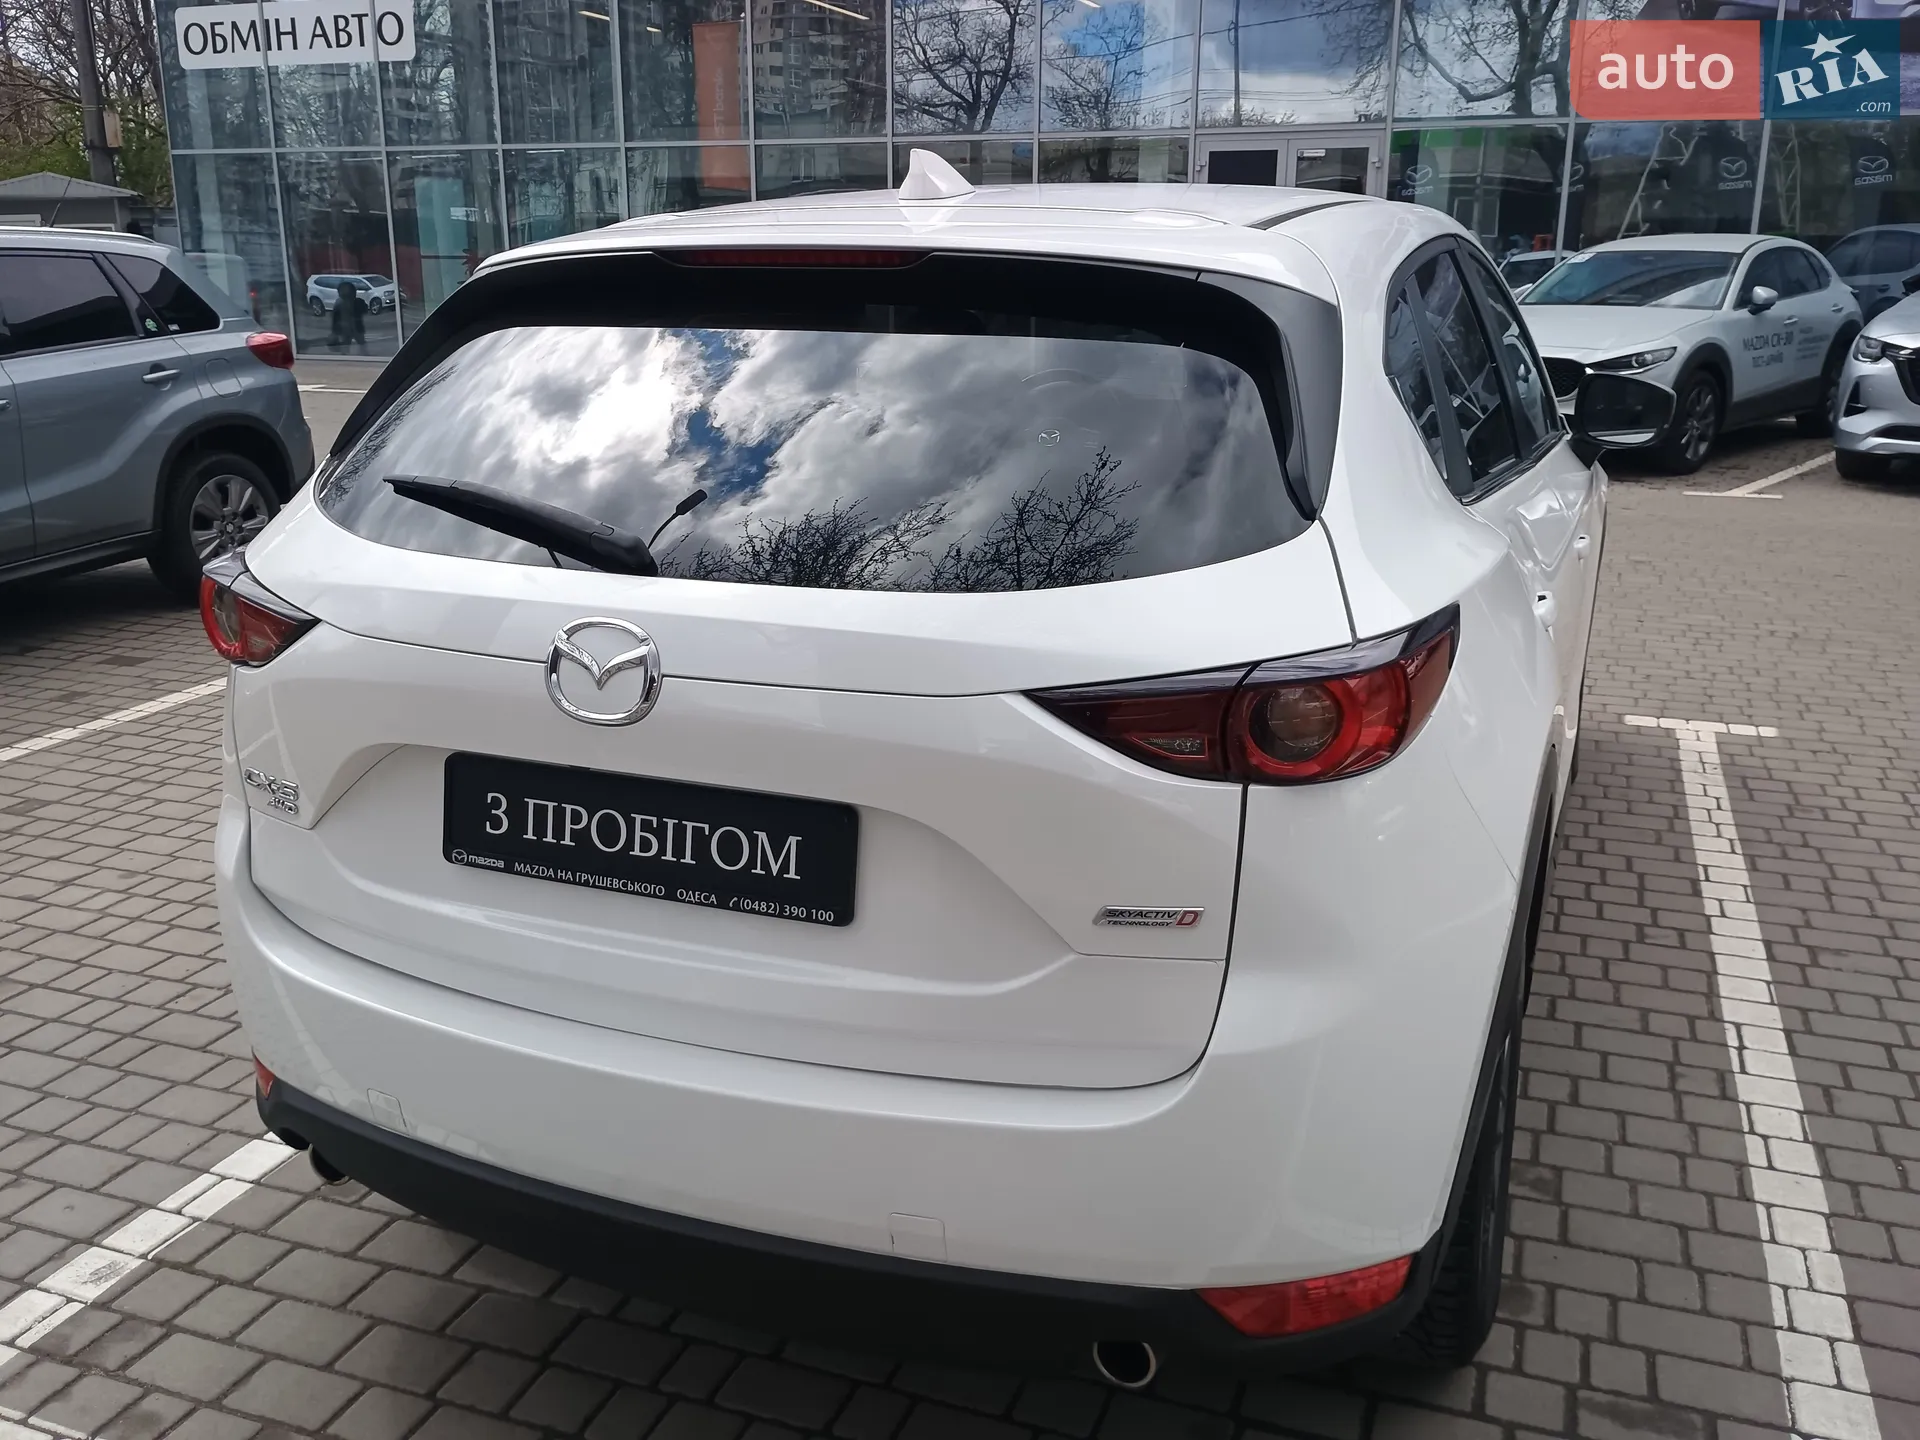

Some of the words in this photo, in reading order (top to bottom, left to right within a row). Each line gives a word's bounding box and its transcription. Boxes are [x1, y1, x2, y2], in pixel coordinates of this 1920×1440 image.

[183, 17, 299, 56] ОБМІН
[309, 10, 405, 50] АВТО
[522, 797, 803, 880] ПРОБІГОМ
[468, 855, 505, 869] mazda
[513, 861, 555, 879] MAZDA
[557, 869, 574, 882] НА
[575, 872, 666, 896] ГРУШЕВСЬКОГО
[676, 888, 718, 906] ОДЕСА
[739, 897, 780, 916] (0482)
[783, 904, 807, 919] 390
[811, 909, 835, 923] 100
[1106, 910, 1178, 919] SKYACTIV
[1175, 910, 1199, 926] D
[1106, 919, 1173, 927] TECHNOLOGY
